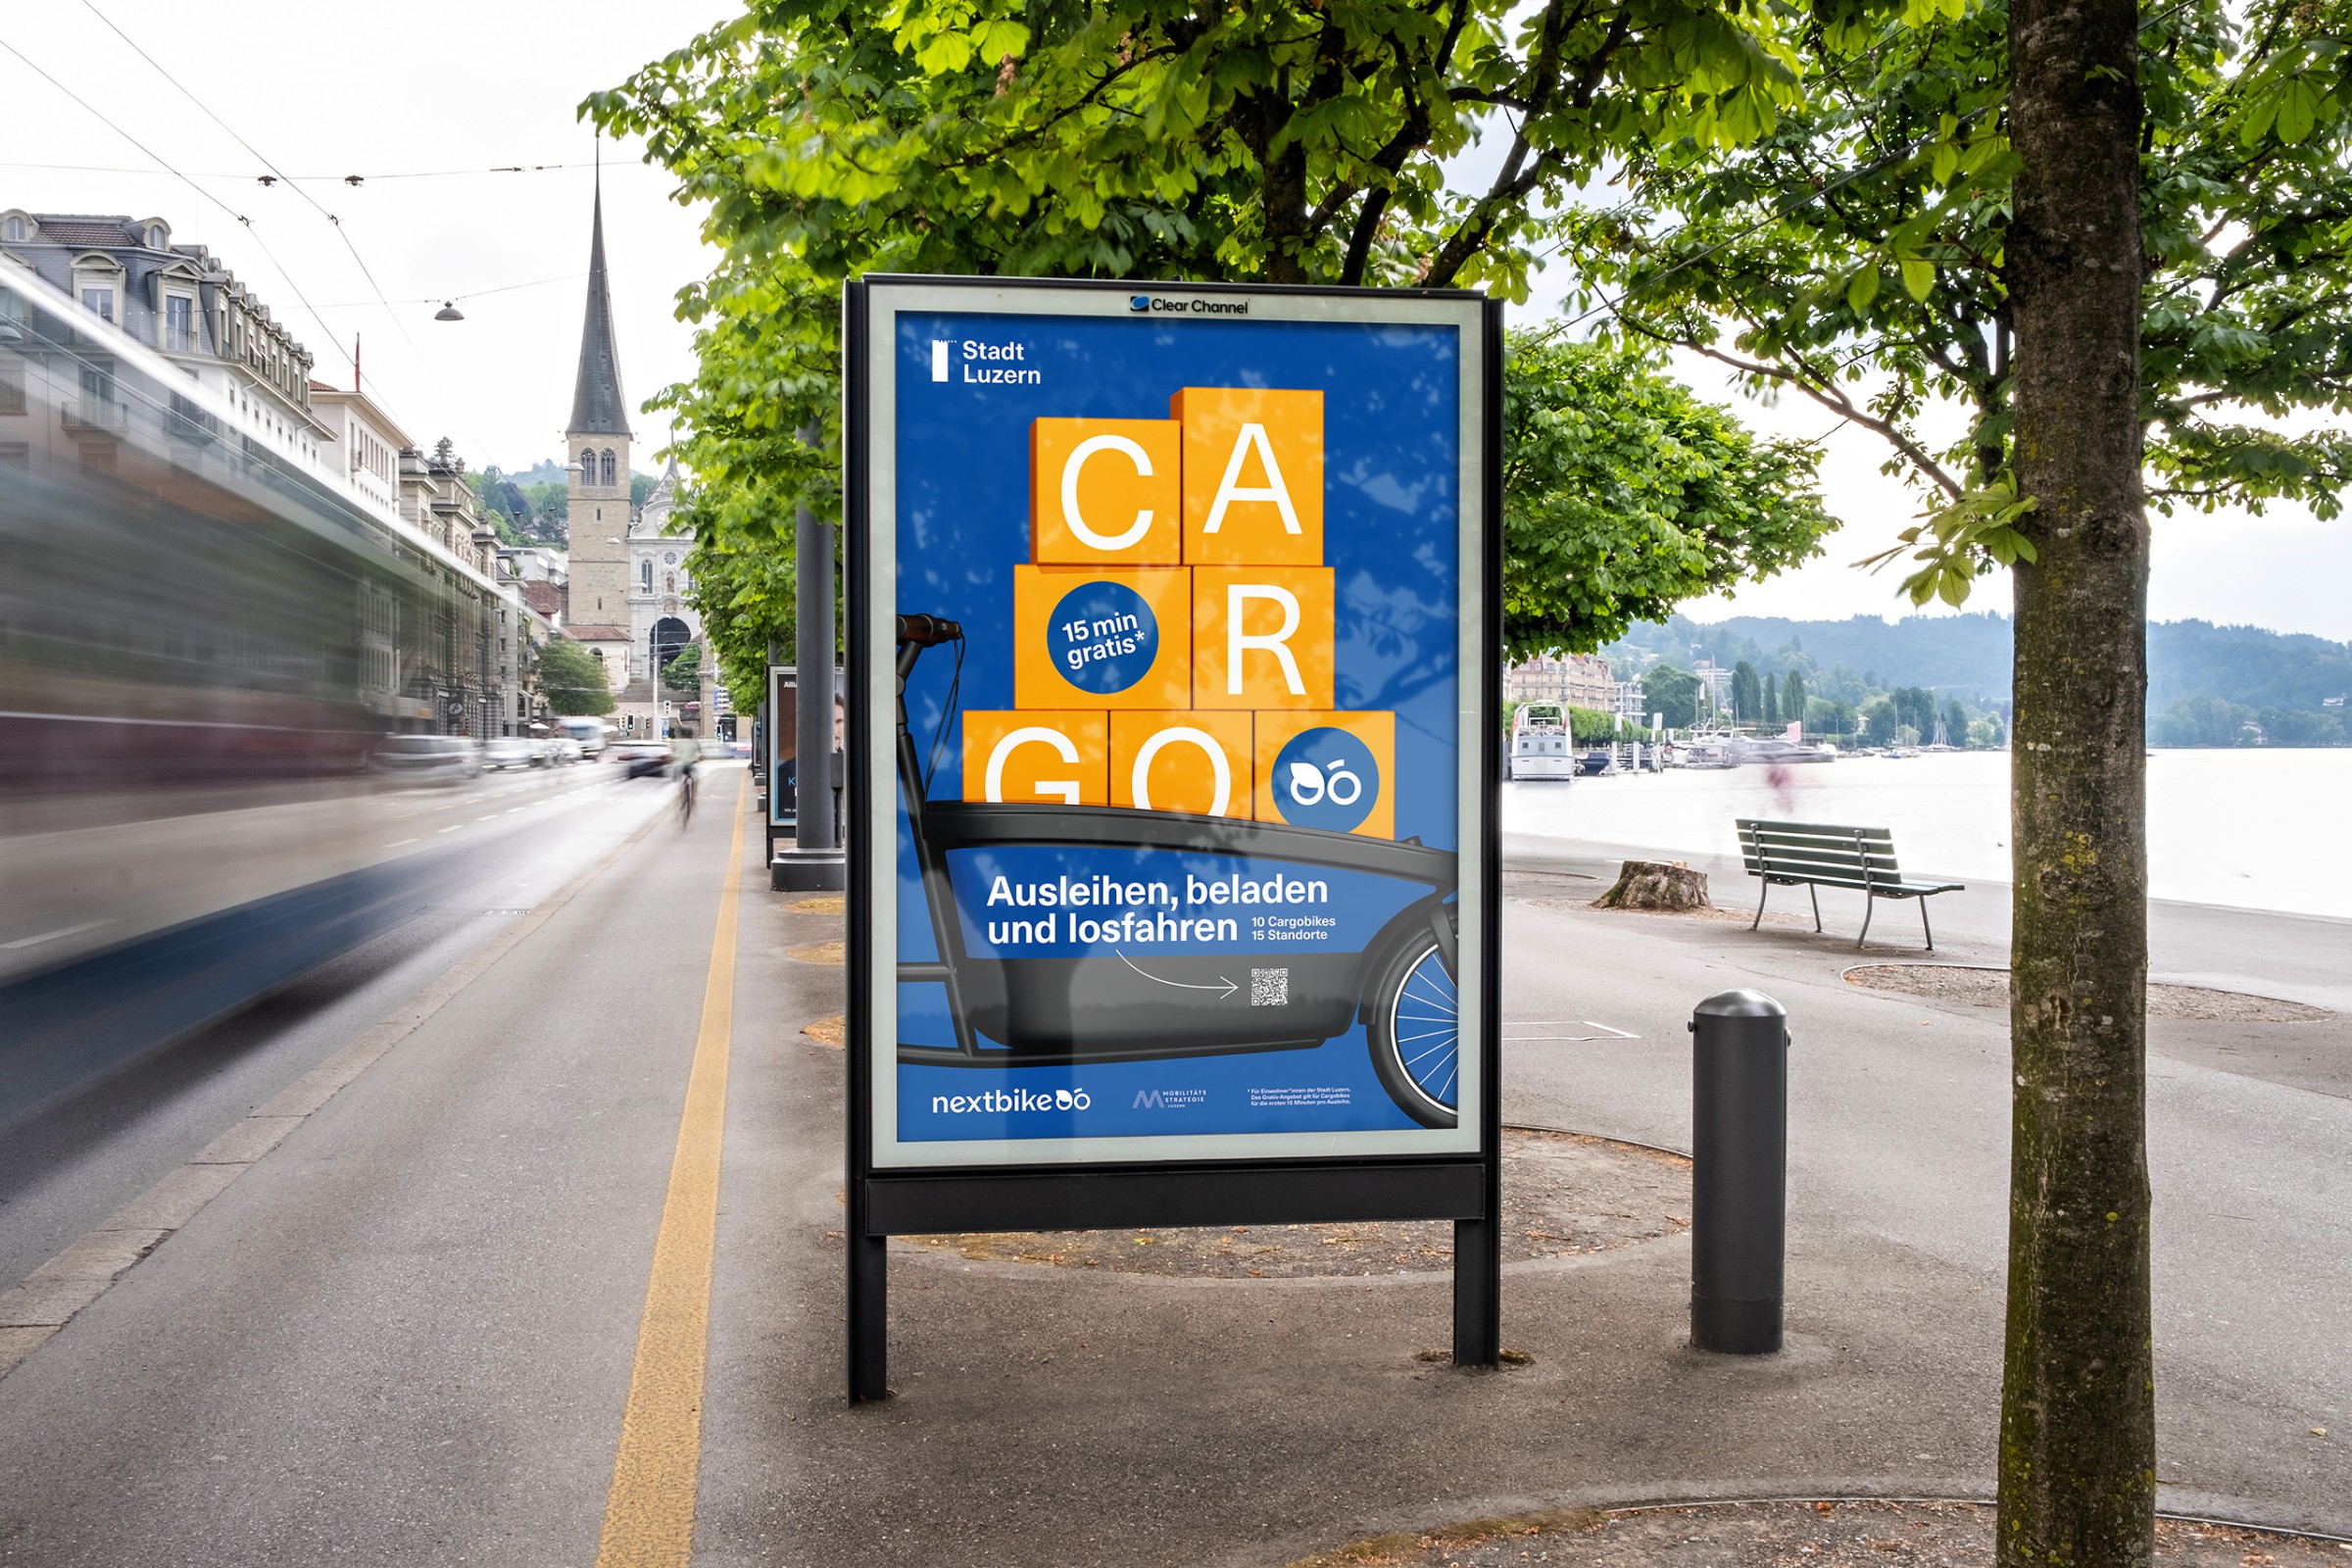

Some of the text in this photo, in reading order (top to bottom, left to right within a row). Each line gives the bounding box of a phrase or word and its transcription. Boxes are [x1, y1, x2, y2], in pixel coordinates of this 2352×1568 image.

[1152, 298, 1249, 314] Clear Channel
[962, 339, 1025, 361] Stadt
[963, 364, 1041, 385] Luzern
[1061, 612, 1139, 643] 15 min
[986, 873, 1329, 911] Ausleihen, beladen
[988, 911, 1239, 945] und losfahren
[1251, 915, 1337, 929] 10 Cargobikes
[1251, 929, 1328, 941] 15 Standorte
[932, 1088, 1053, 1113] nextbike
